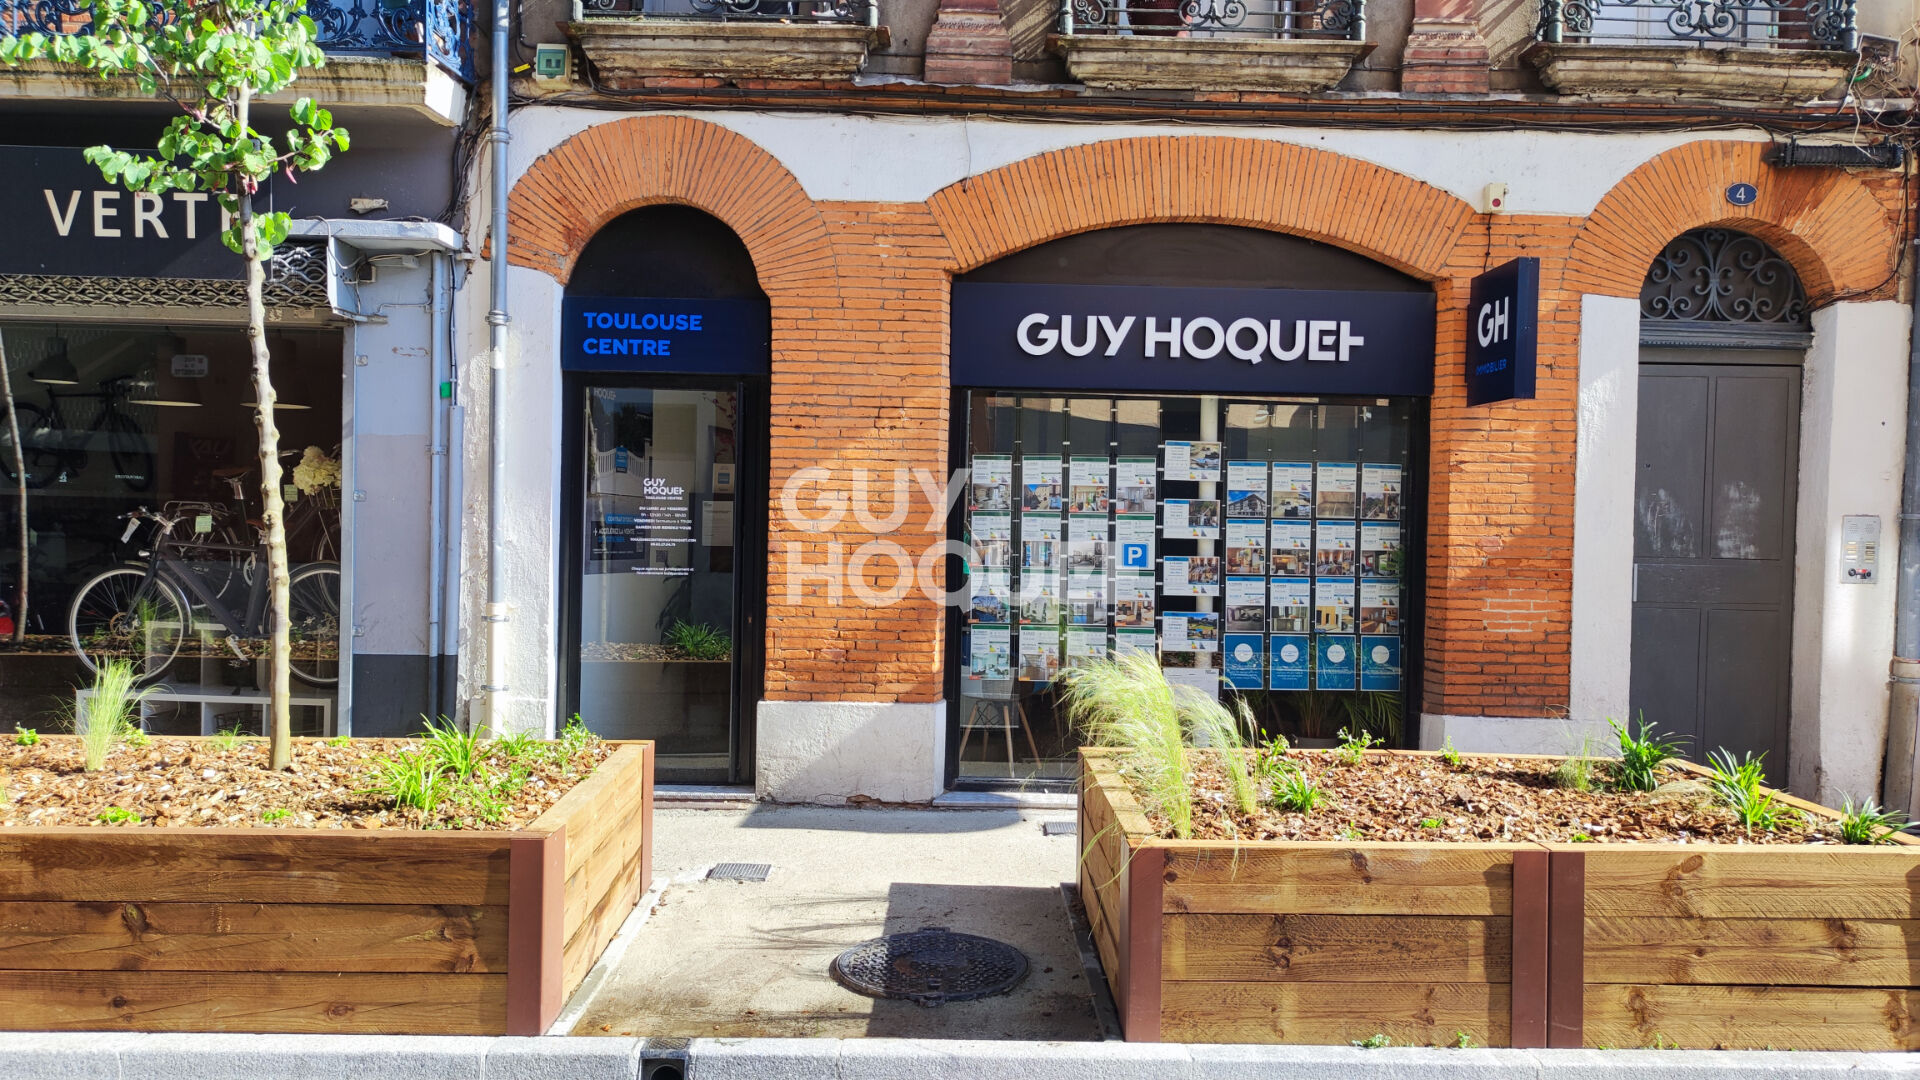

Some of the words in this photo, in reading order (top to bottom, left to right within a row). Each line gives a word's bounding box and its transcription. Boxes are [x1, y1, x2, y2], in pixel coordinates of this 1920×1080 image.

[1736, 187, 1746, 201] 4
[583, 312, 703, 331] TOULOUSE
[1477, 296, 1509, 348] GH
[583, 337, 671, 356] CENTRE
[1016, 312, 1136, 357] GUY
[1144, 316, 1365, 365] HOQUET
[643, 478, 666, 487] GUY
[1127, 546, 1143, 565] P
